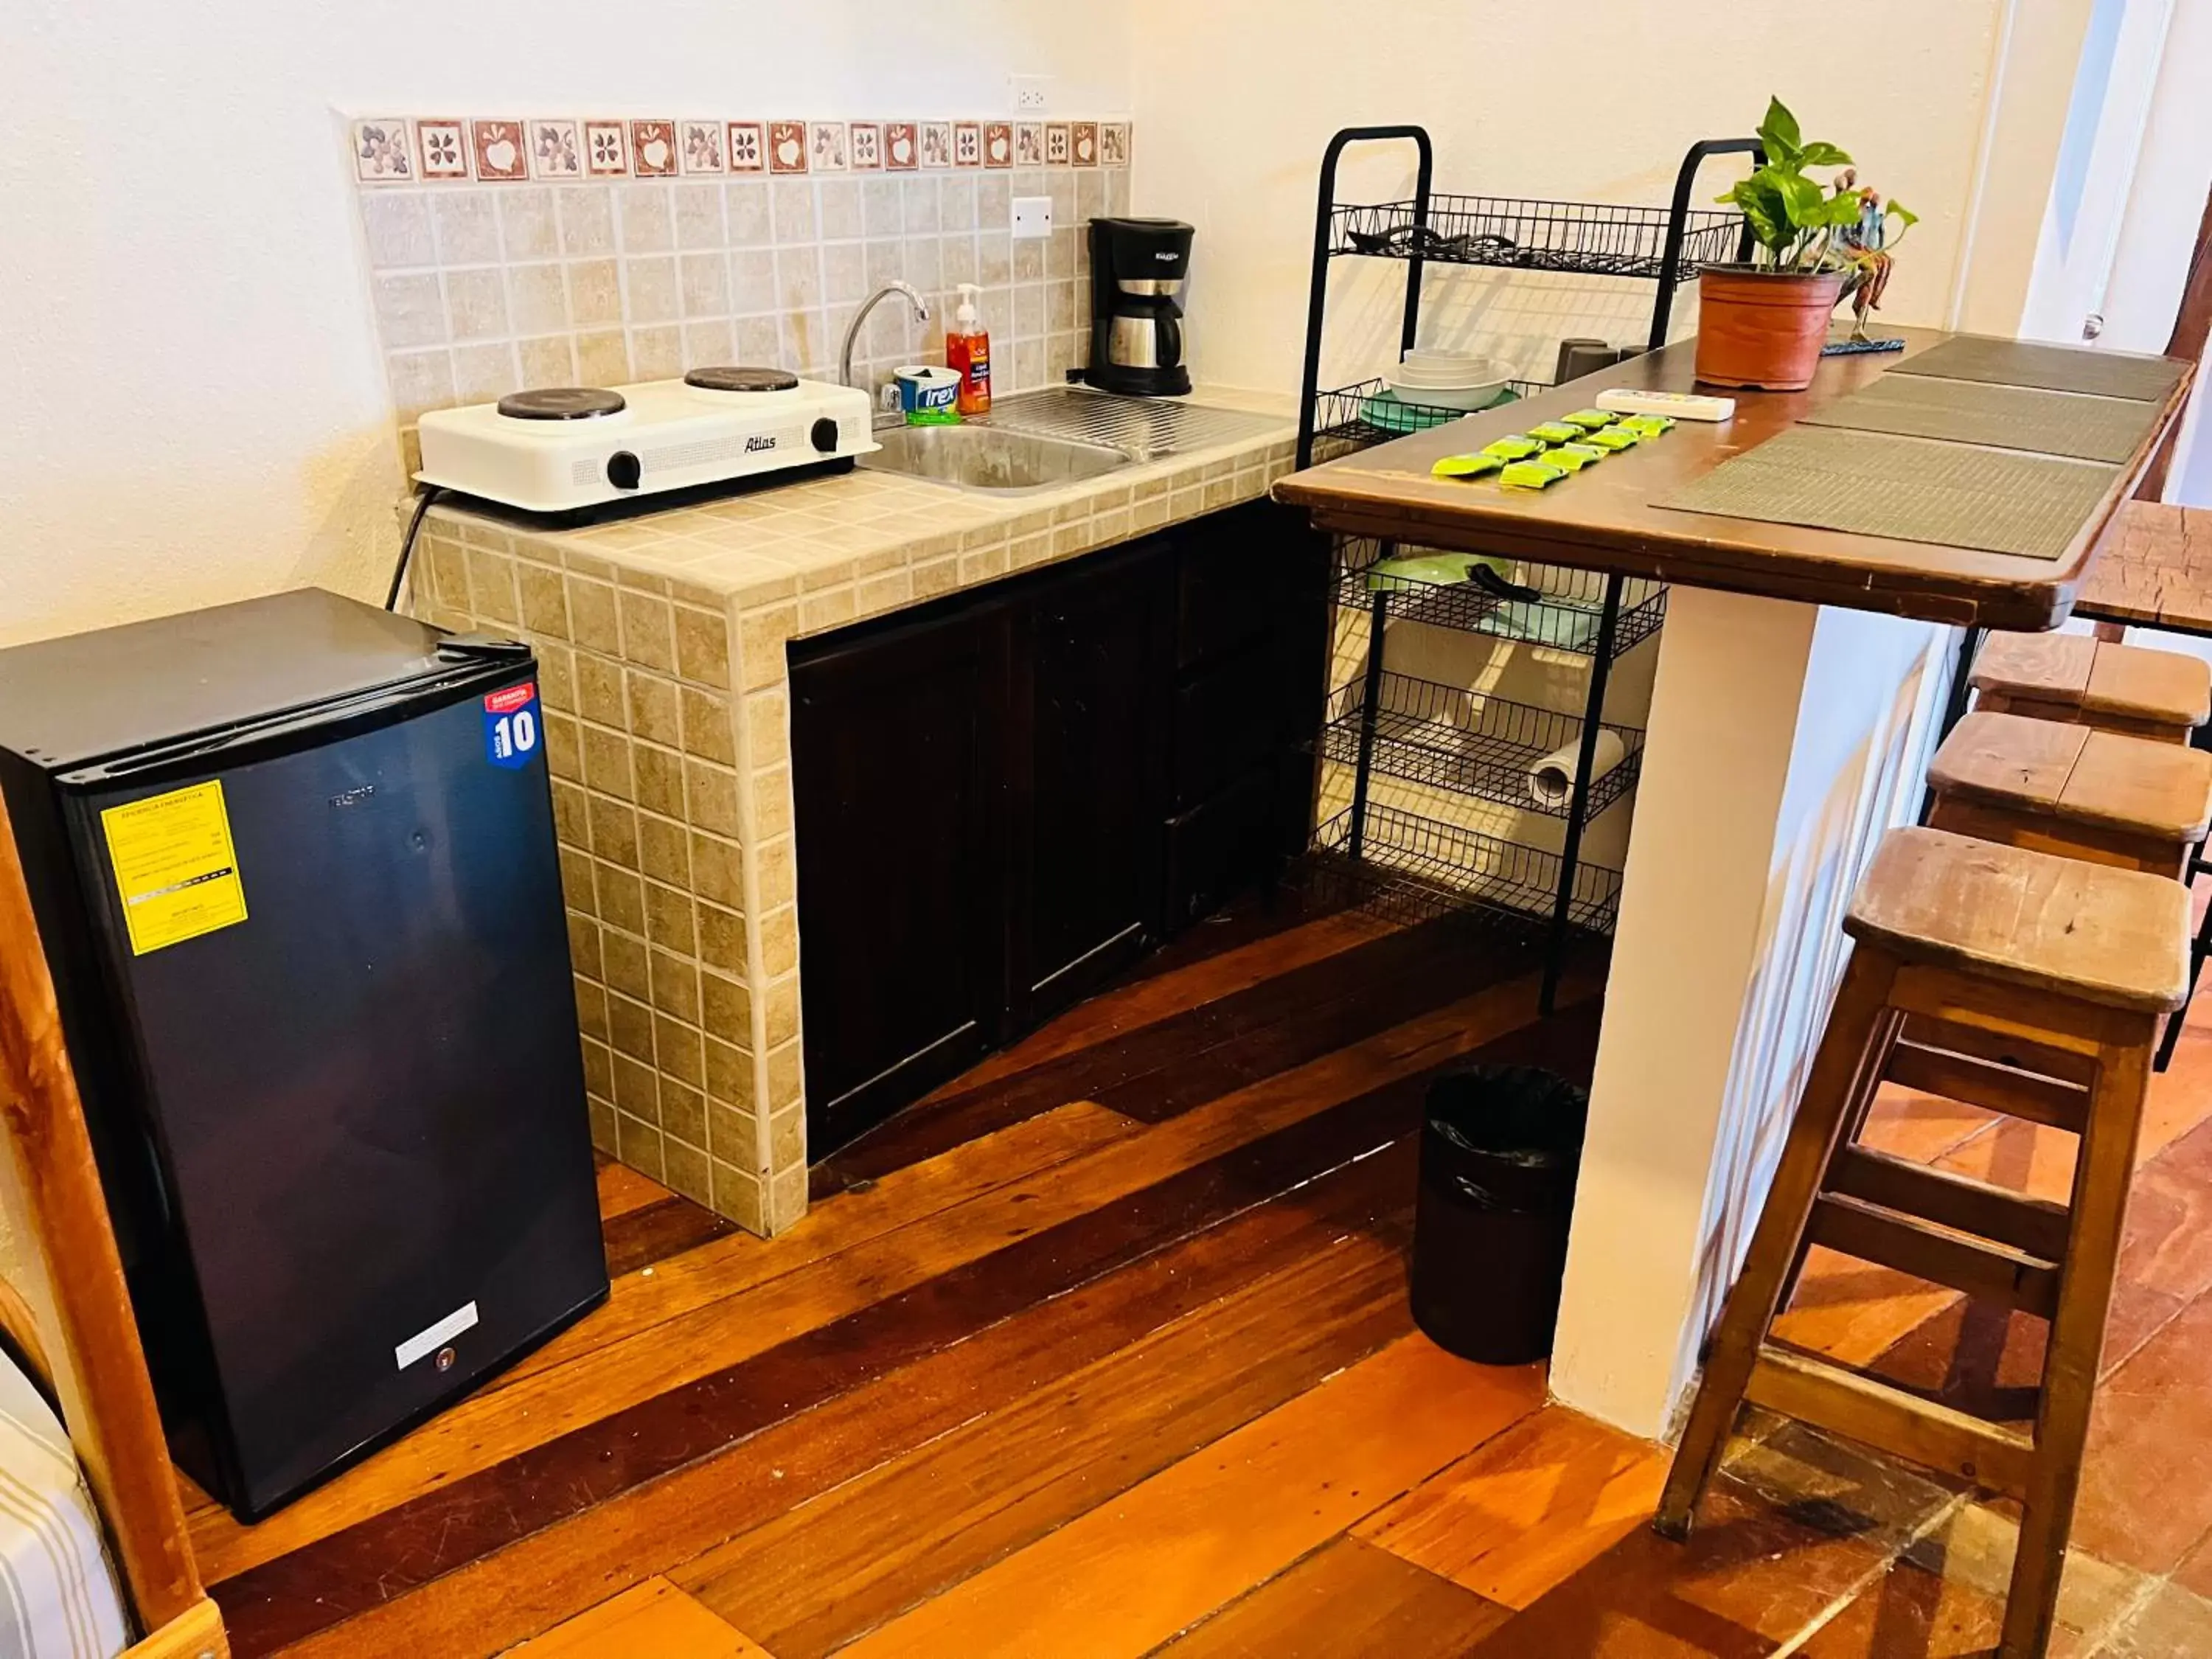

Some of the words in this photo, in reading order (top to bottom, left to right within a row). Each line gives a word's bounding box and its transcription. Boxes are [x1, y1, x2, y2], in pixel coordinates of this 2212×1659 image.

[925, 385, 956, 406] Irex
[744, 437, 776, 453] Atlas
[495, 711, 535, 757] 10
